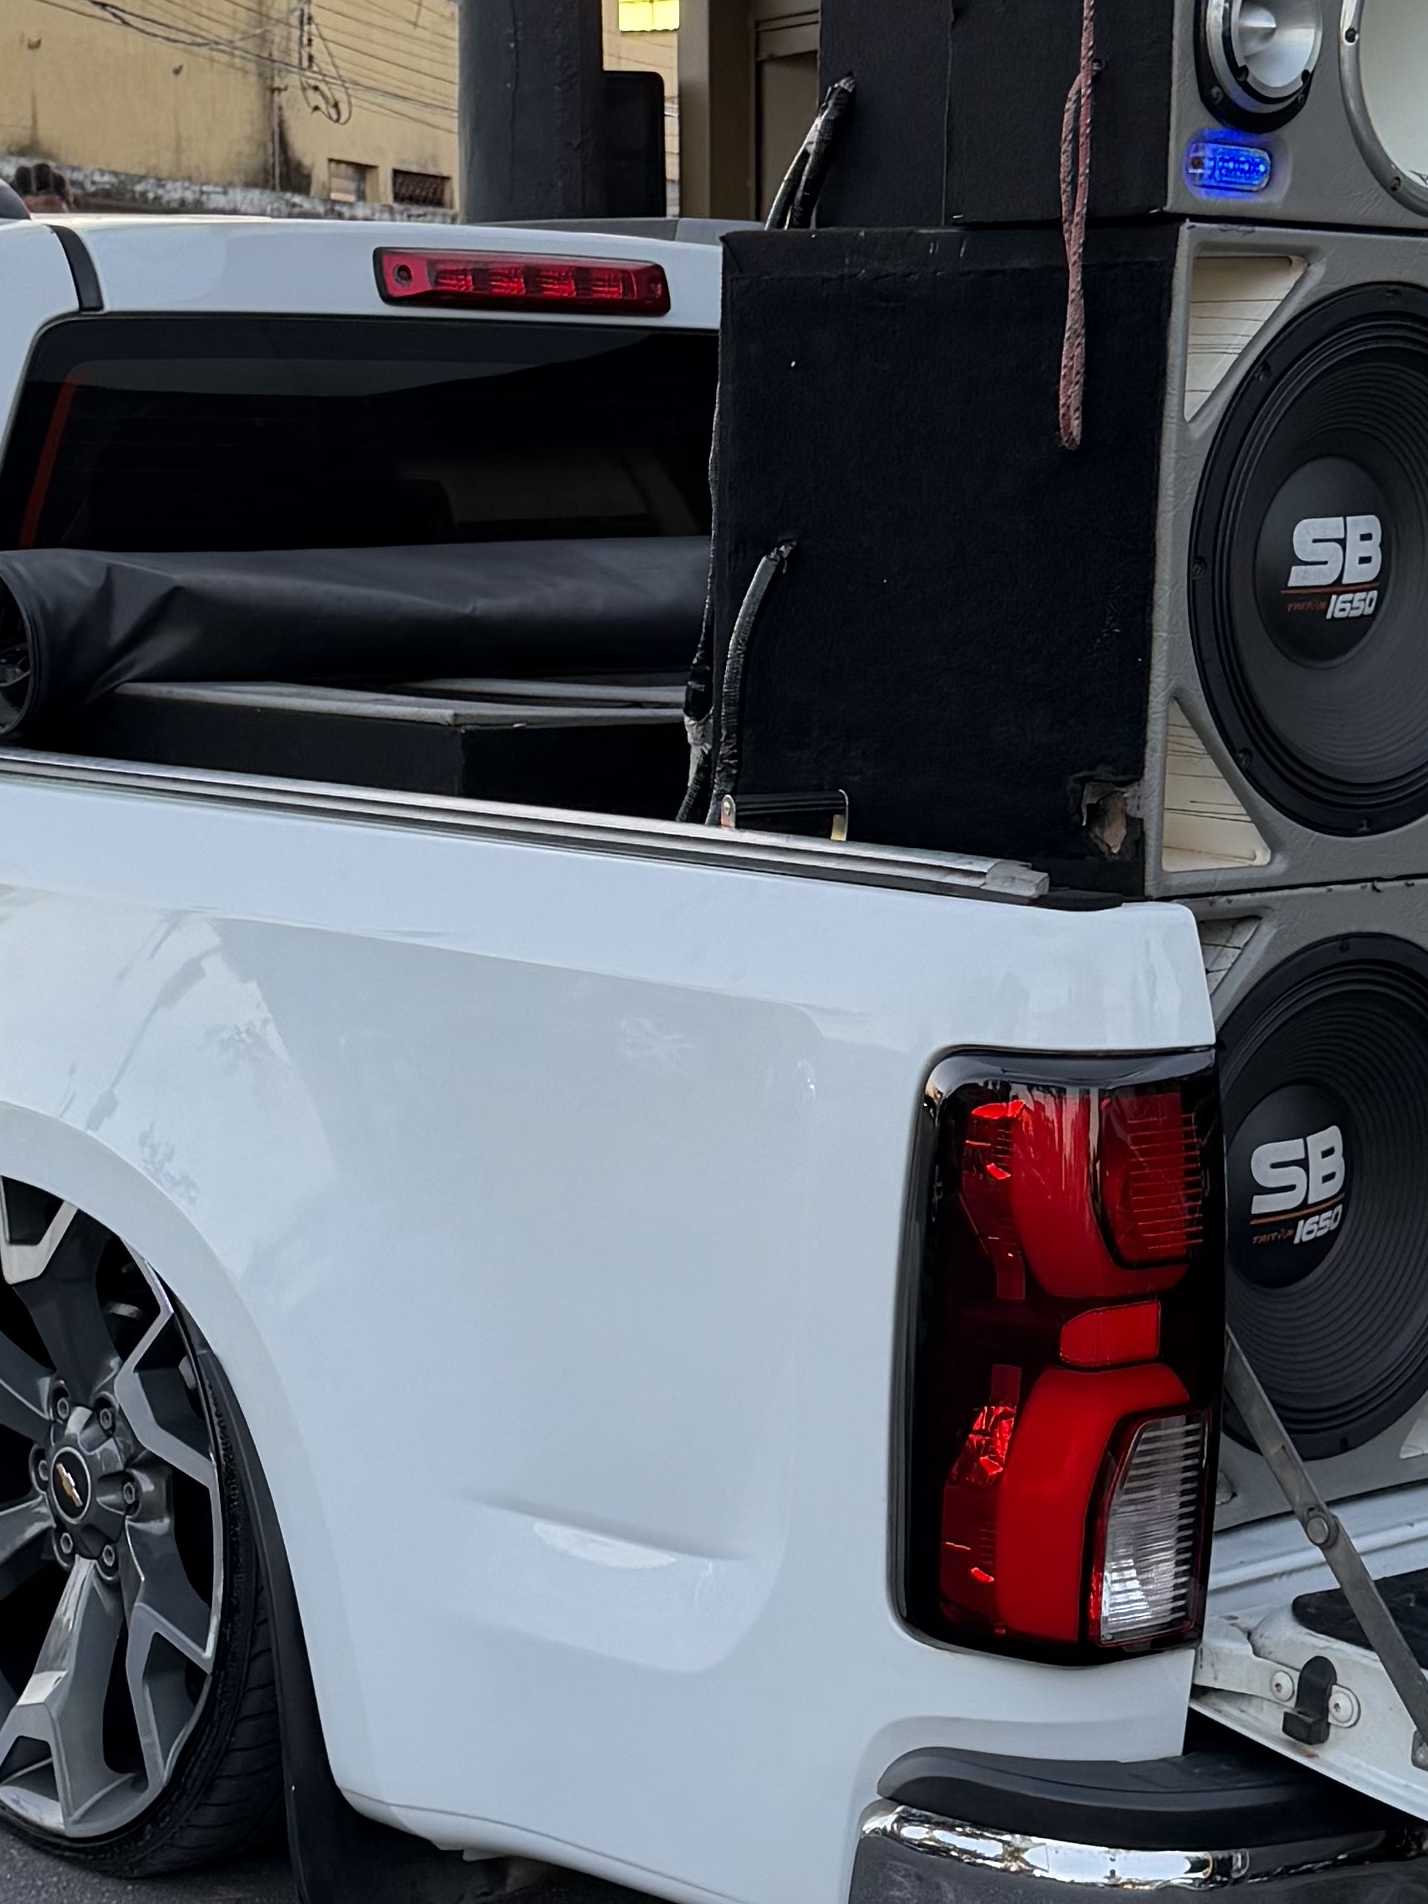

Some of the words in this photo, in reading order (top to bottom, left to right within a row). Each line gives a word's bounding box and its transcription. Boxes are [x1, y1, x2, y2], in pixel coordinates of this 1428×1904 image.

[1288, 515, 1382, 587] SB
[1326, 590, 1378, 620] 1650
[1251, 1125, 1345, 1215] SB
[1293, 1204, 1343, 1245] 1650
